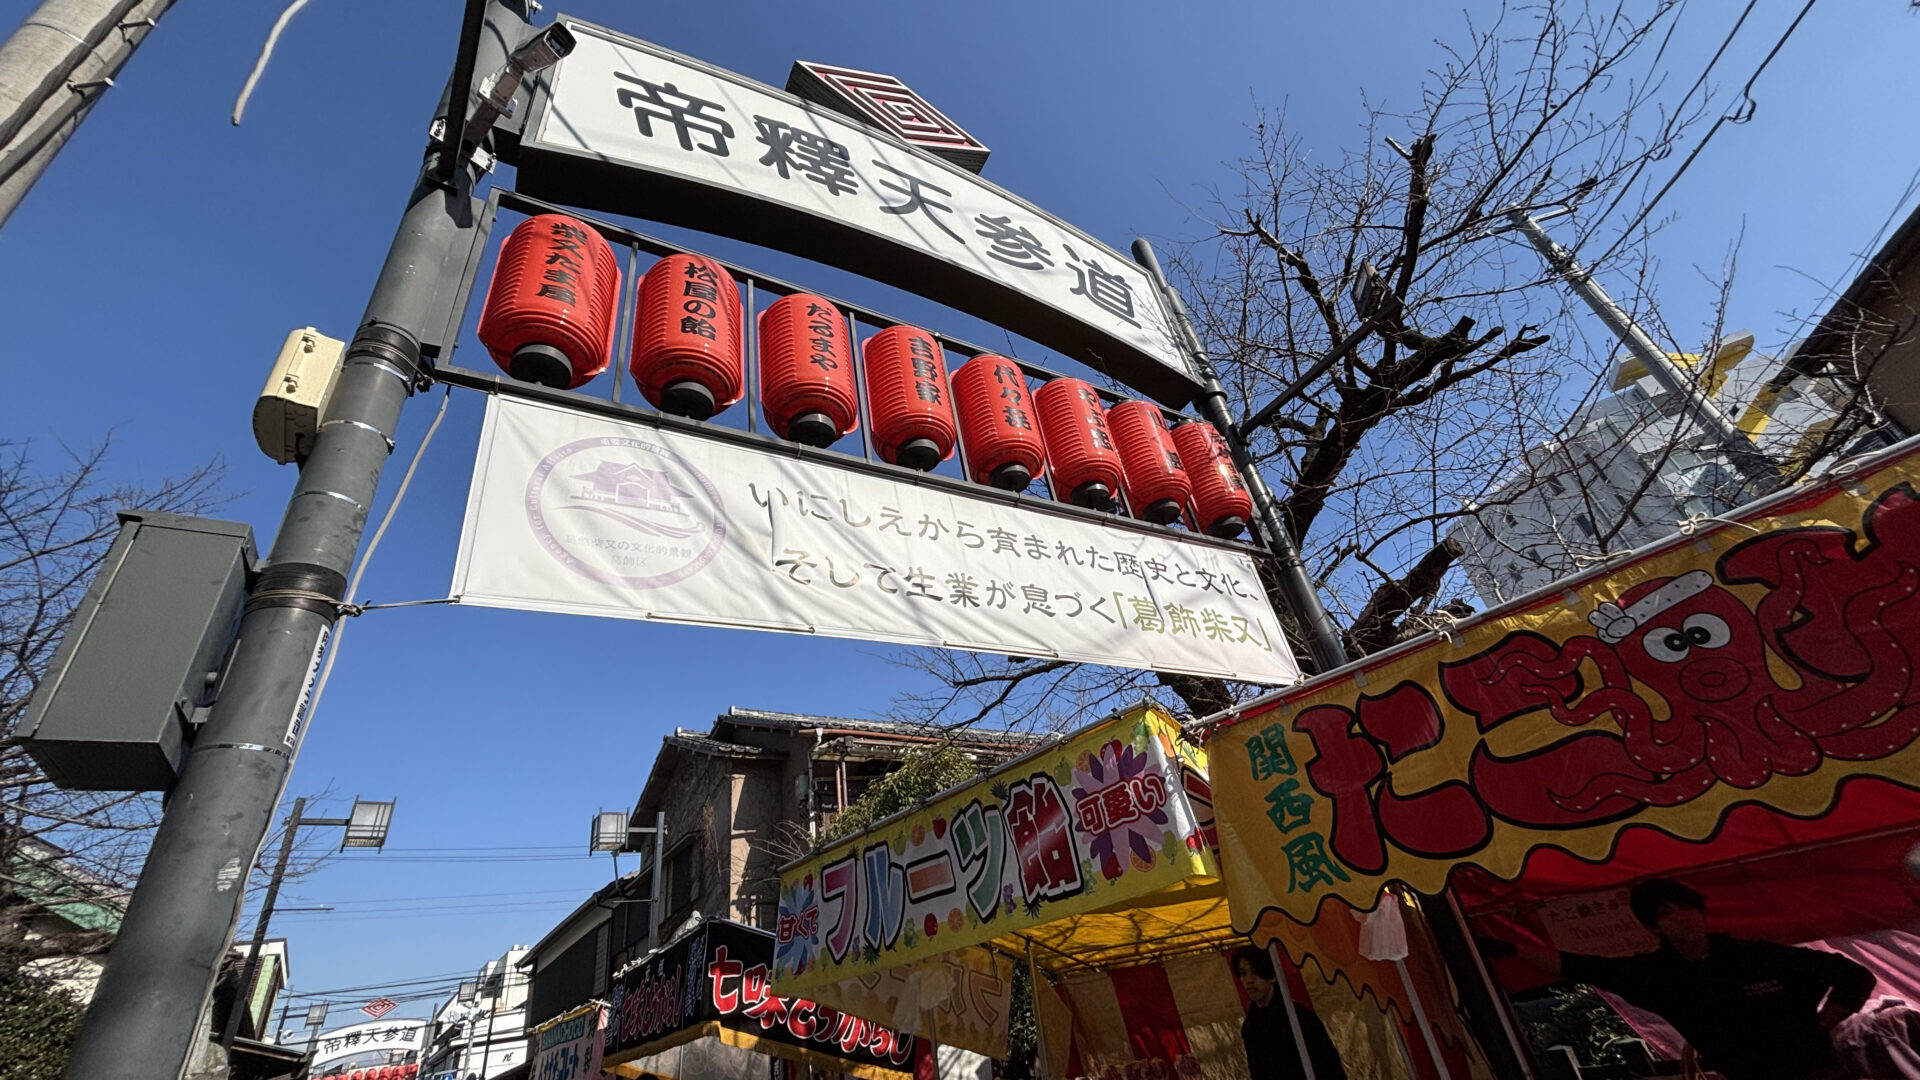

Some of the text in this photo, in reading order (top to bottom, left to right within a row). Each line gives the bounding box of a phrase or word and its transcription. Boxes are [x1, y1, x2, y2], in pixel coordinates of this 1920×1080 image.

[613, 71, 1142, 329] 帝釋天参道
[681, 261, 718, 340] 松屋の飴
[908, 336, 942, 406] 吉野家
[1077, 773, 1168, 836] 可愛い
[1245, 722, 1351, 895] 関西風
[820, 771, 1083, 965] フルーツ飴
[778, 905, 820, 944] 甘くて
[324, 1025, 416, 1054] 帝釋天参道
